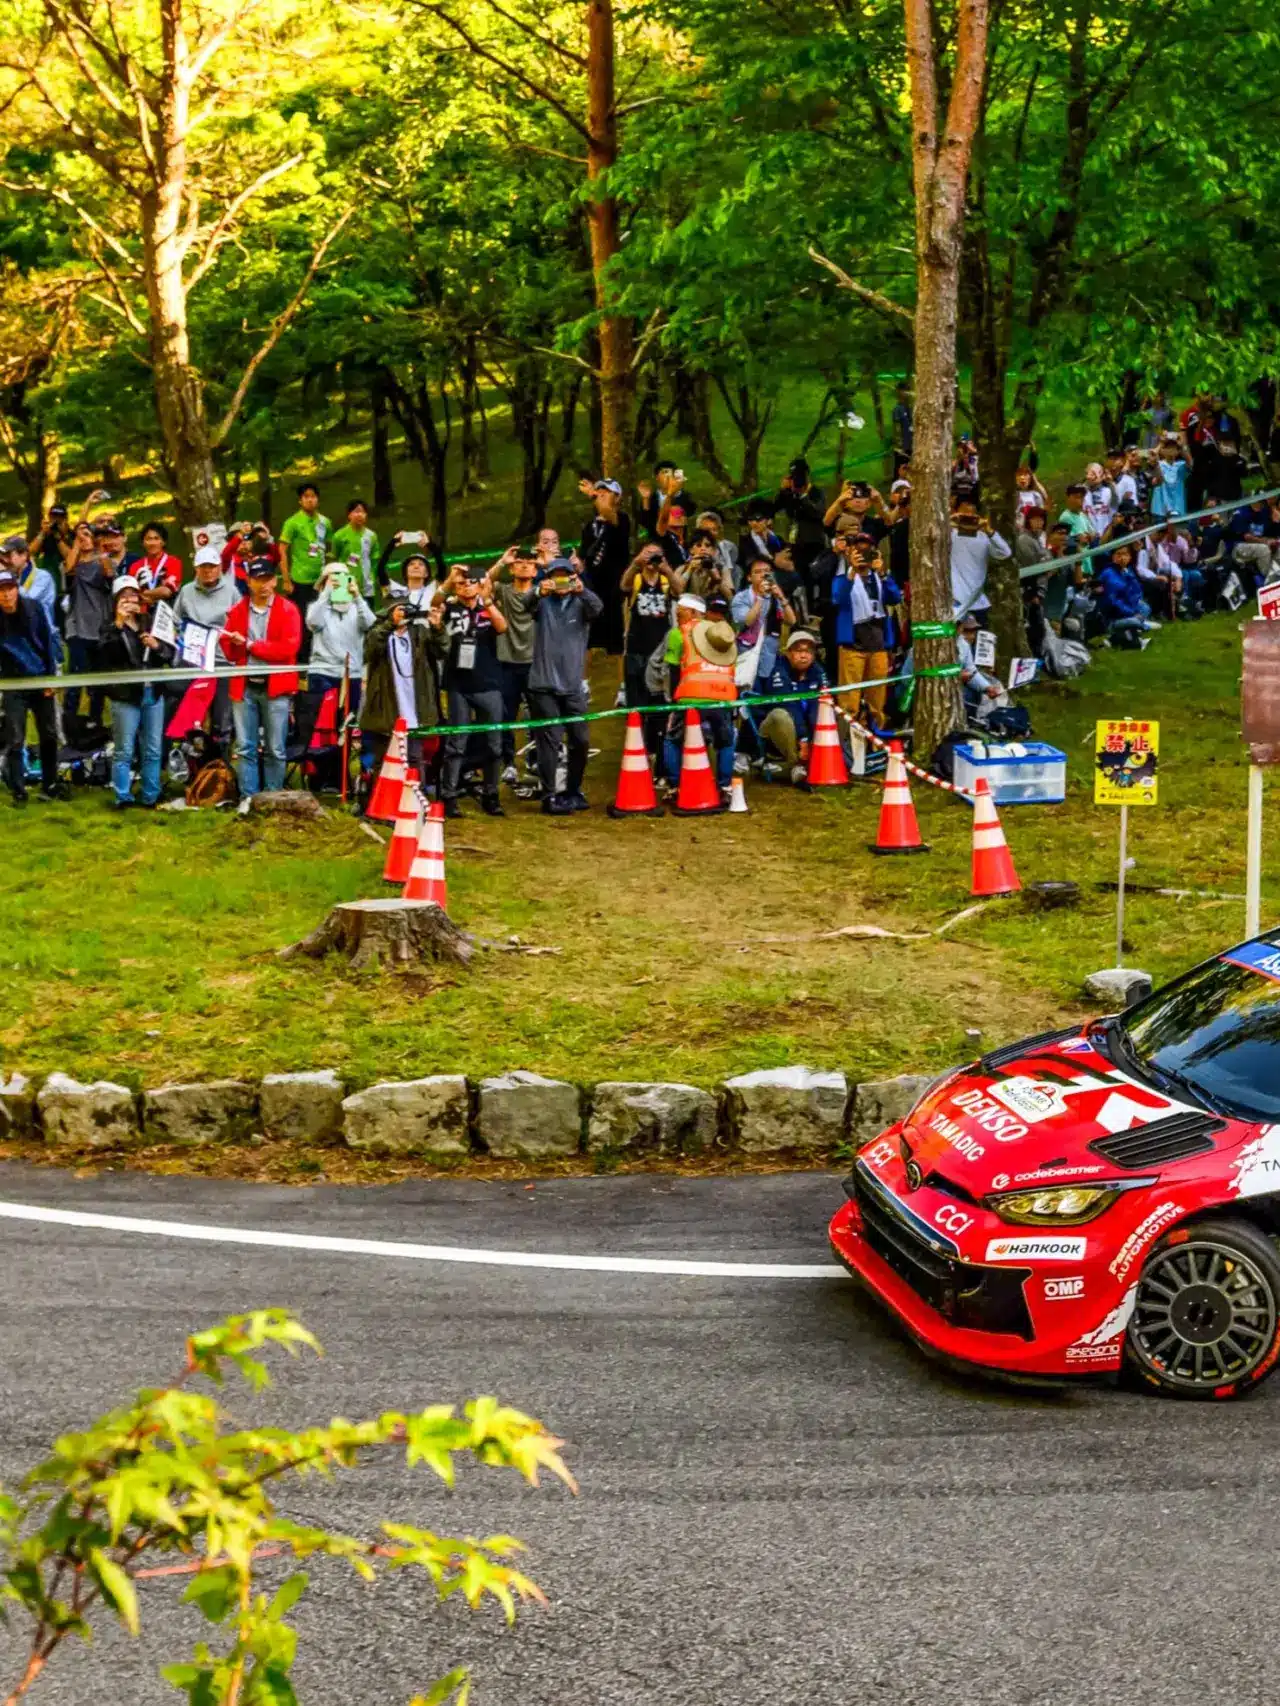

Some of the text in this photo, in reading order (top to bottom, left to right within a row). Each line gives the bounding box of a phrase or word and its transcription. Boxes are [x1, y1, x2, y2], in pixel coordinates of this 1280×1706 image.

[928, 1113, 986, 1162] TAMADIC
[950, 1088, 1030, 1142] DENSO
[1014, 1165, 1102, 1183] codebeamer
[1108, 1201, 1175, 1275] Panasonic
[1117, 1205, 1186, 1284] AUTOMOTIVE
[1044, 1278, 1085, 1296] OMP
